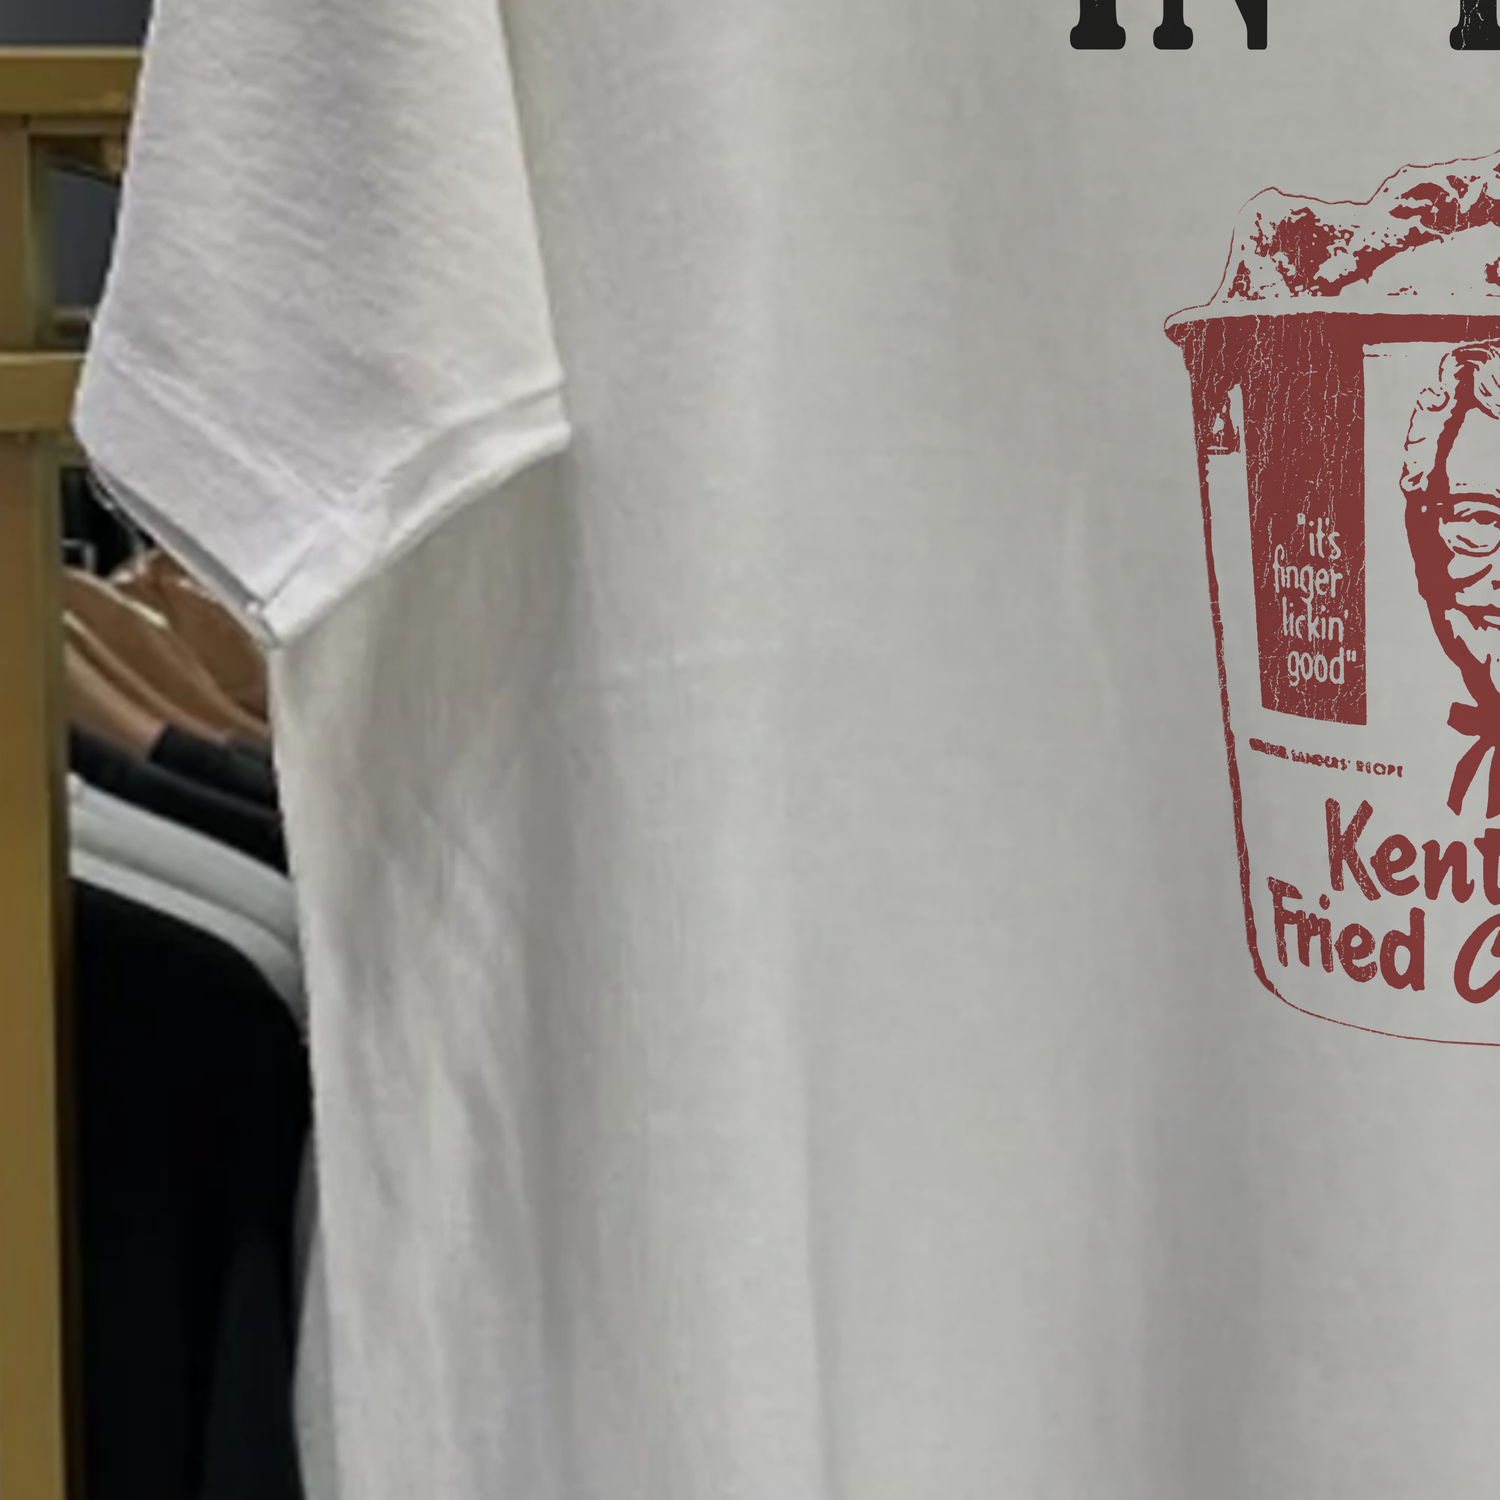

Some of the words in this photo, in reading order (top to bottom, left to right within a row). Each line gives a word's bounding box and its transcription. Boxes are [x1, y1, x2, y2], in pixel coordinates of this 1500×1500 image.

[1273, 544, 1343, 602] finger
[1282, 597, 1349, 642] lickin'
[1287, 647, 1356, 687] good"
[1266, 876, 1425, 992] Fried
